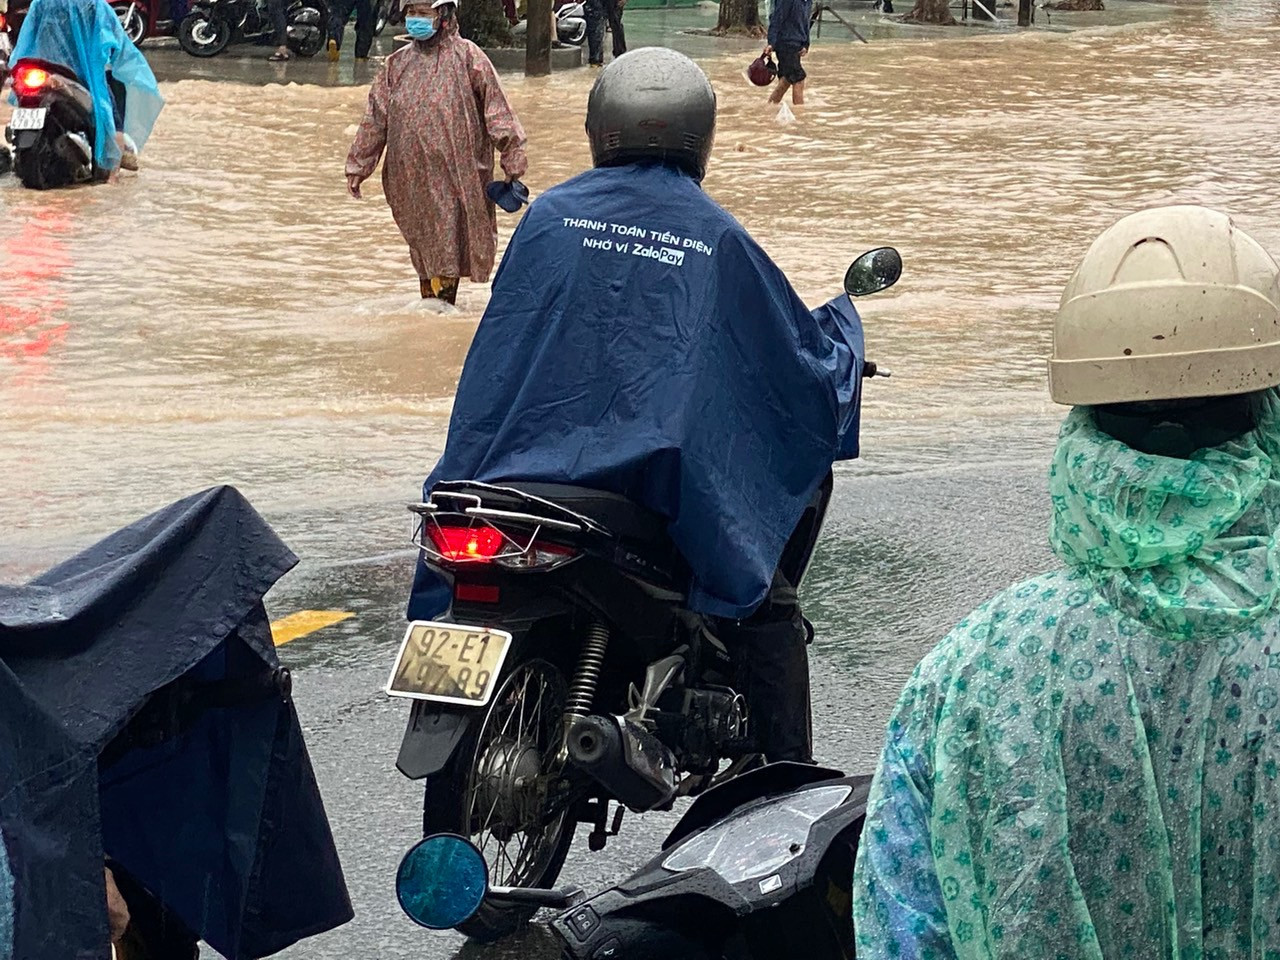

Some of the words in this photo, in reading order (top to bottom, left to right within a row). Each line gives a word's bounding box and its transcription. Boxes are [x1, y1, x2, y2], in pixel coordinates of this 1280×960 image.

[563, 217, 607, 232] THANH
[610, 224, 647, 239] TOÁN
[683, 238, 713, 256] ĐIỆN
[615, 243, 630, 253] VÍ
[632, 243, 685, 266] ZaloPay
[417, 629, 491, 664] 92-E1
